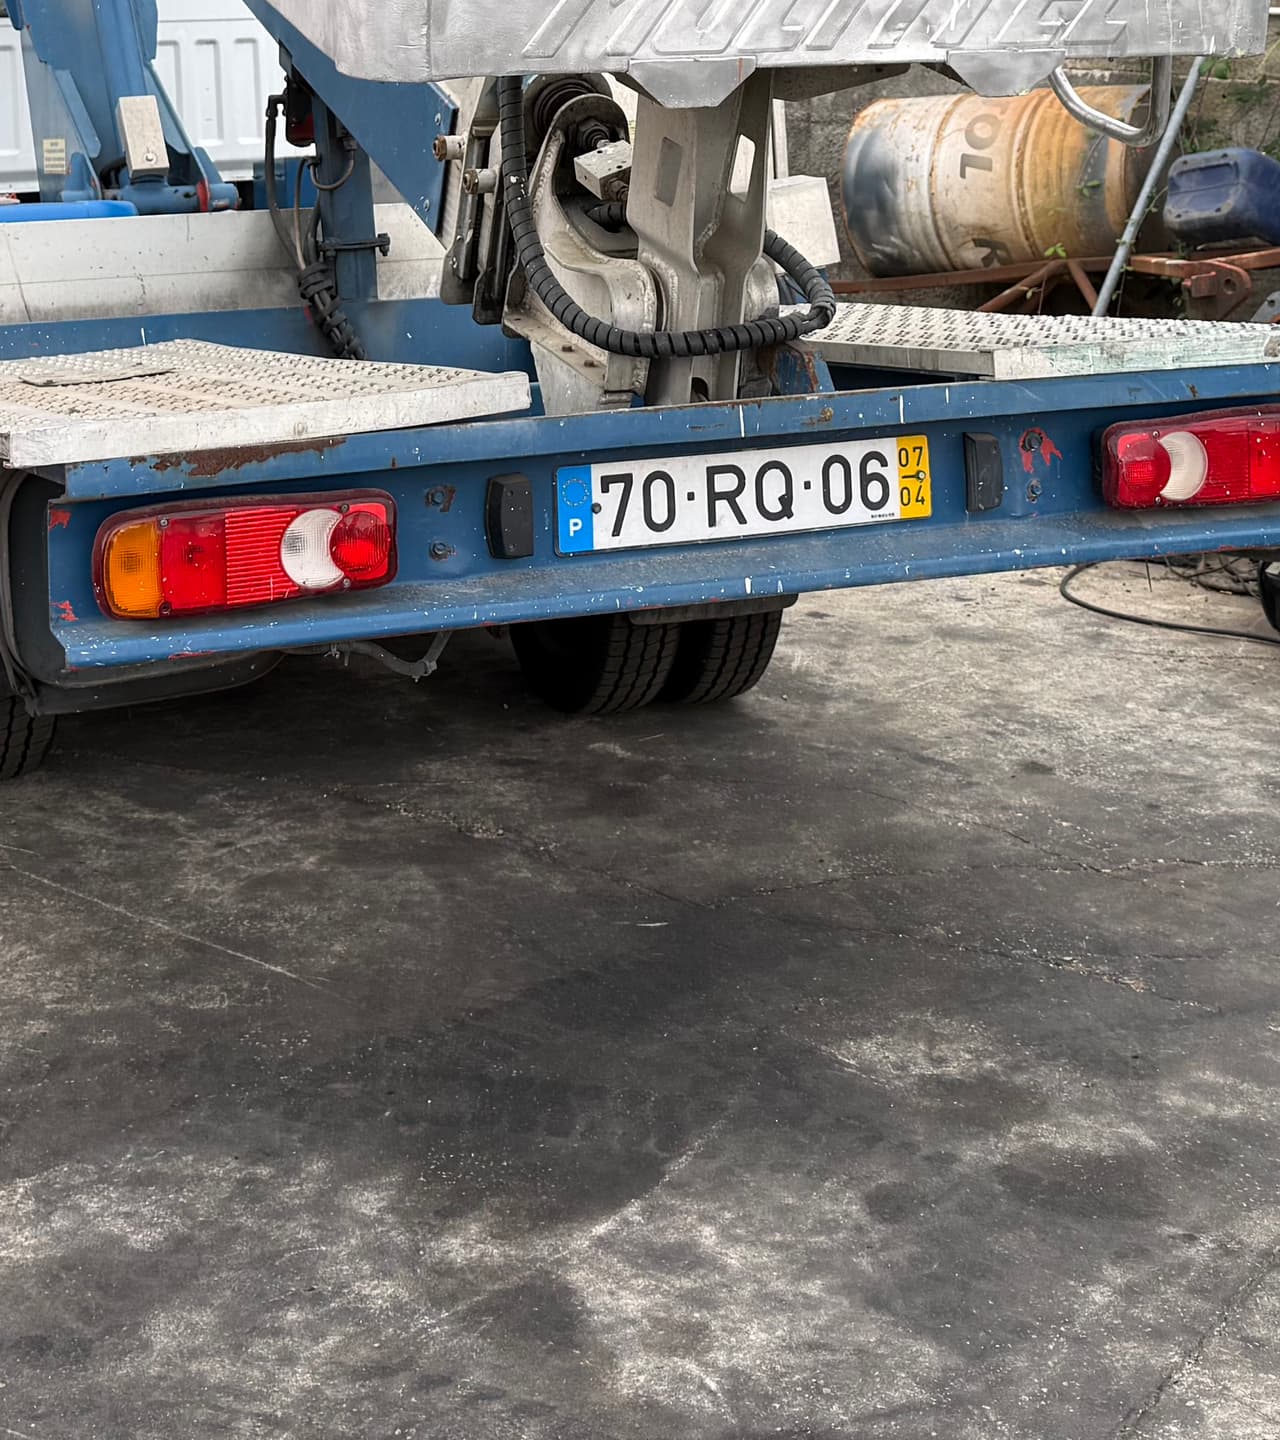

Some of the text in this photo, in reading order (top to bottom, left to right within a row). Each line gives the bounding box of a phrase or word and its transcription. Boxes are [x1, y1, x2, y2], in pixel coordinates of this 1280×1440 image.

[898, 446, 924, 469] 07
[900, 487, 926, 507] 04
[569, 518, 582, 537] P
